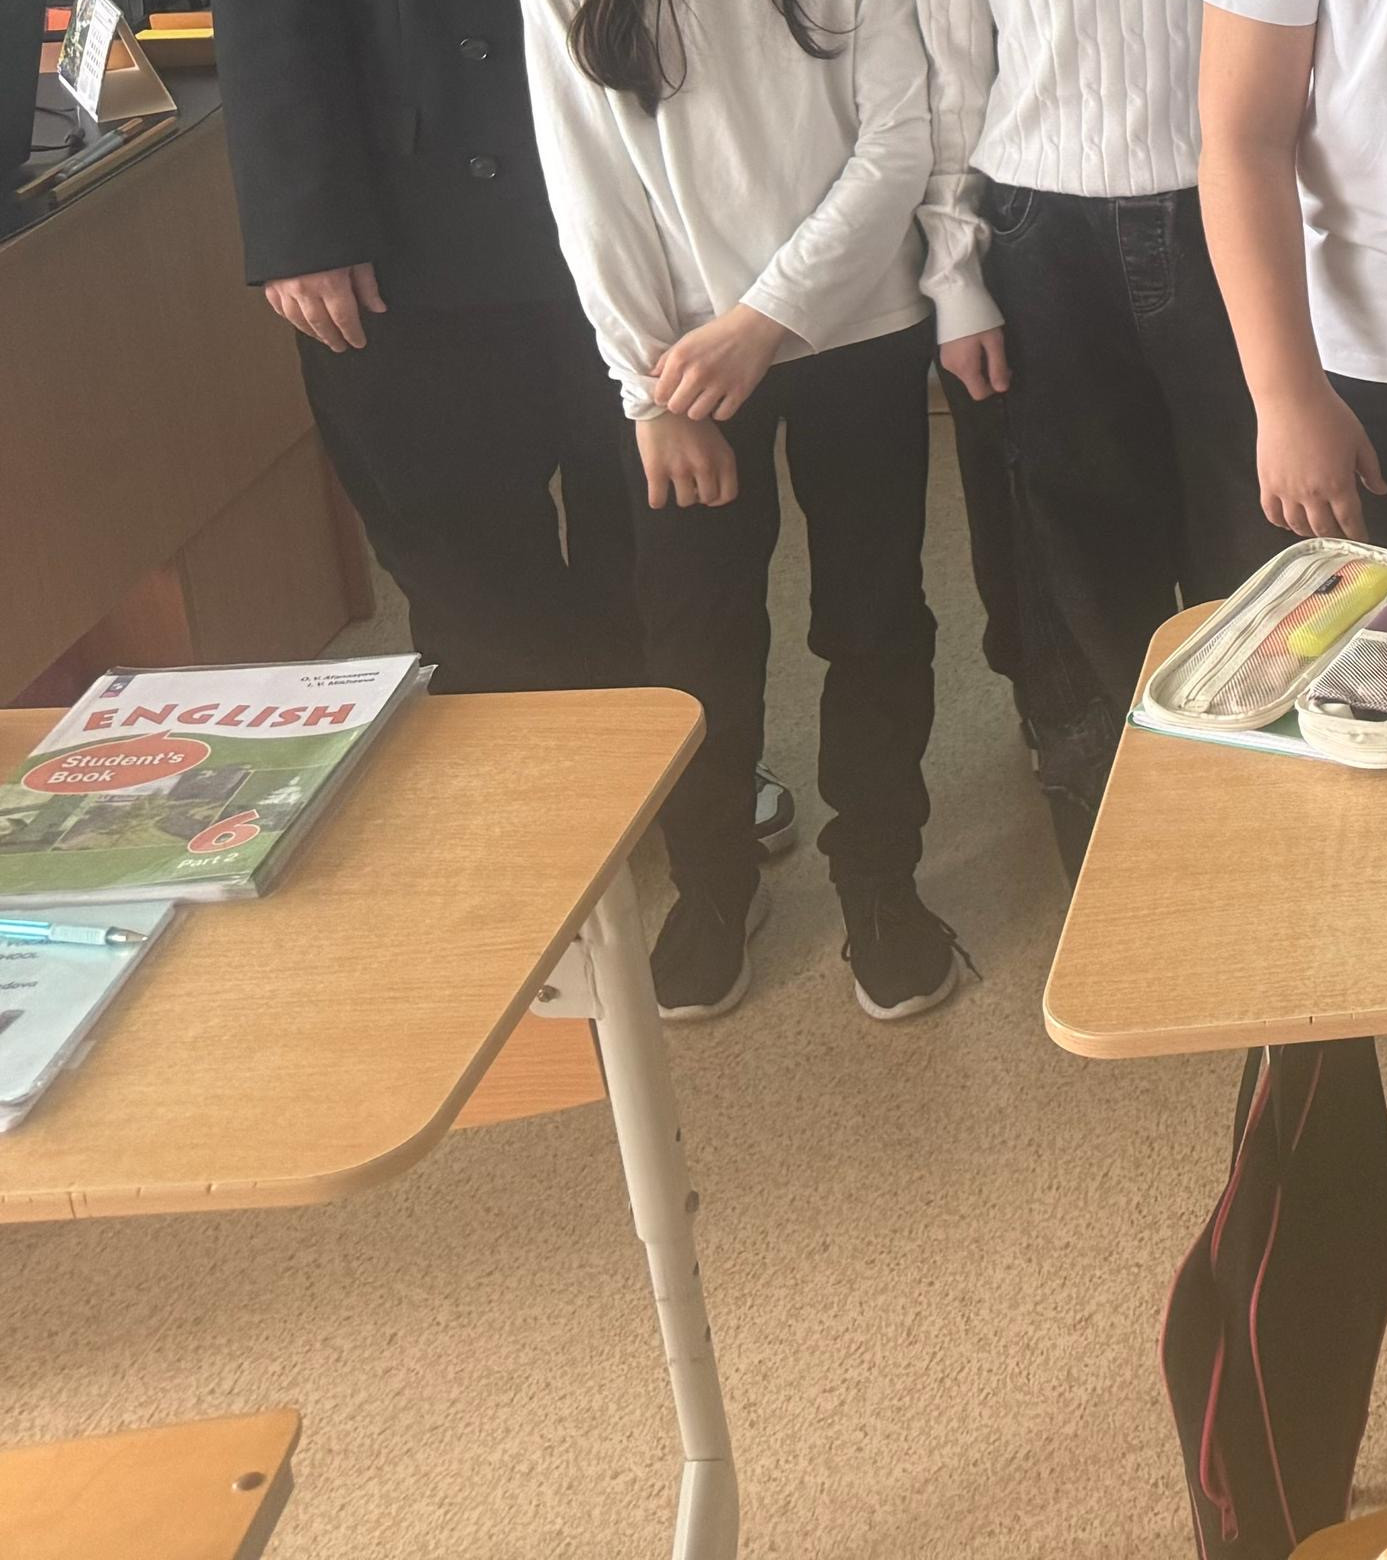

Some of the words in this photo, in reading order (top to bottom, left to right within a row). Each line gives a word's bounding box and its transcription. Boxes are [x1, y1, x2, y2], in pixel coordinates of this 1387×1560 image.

[82, 701, 357, 732] ENGLISH
[62, 751, 185, 769] Student's
[48, 768, 116, 785] Book
[187, 808, 262, 854] 6
[177, 853, 227, 870] Part
[227, 852, 239, 864] 2
